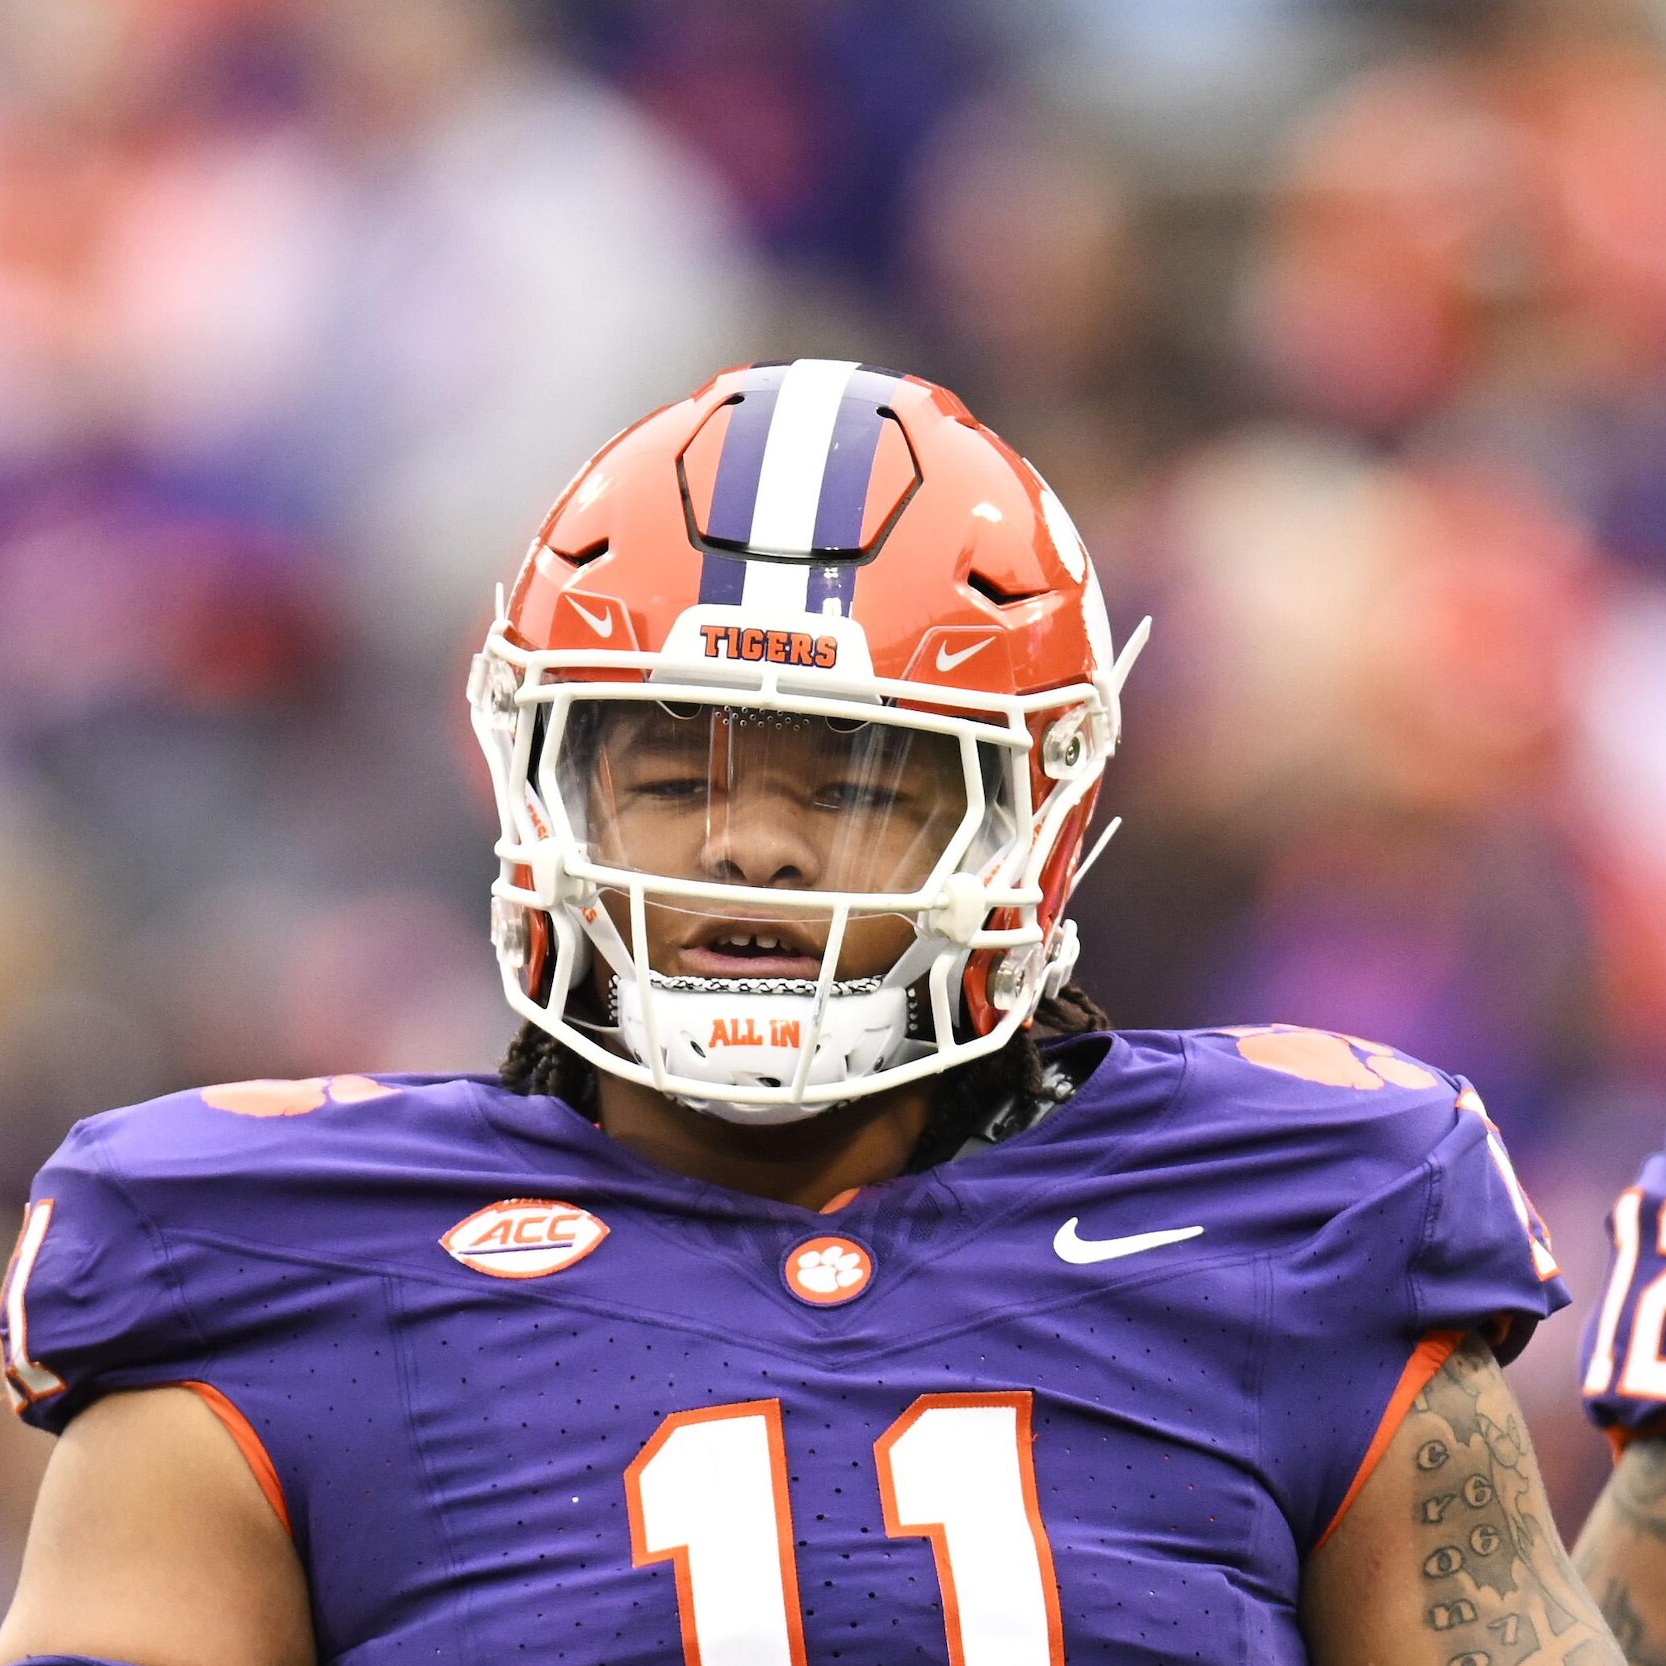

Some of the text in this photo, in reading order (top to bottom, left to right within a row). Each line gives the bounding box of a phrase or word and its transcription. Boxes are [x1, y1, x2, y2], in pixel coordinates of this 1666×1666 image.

[699, 624, 839, 669] TIGERS
[708, 1018, 801, 1049] ALL IN
[469, 1213, 585, 1248] ACC
